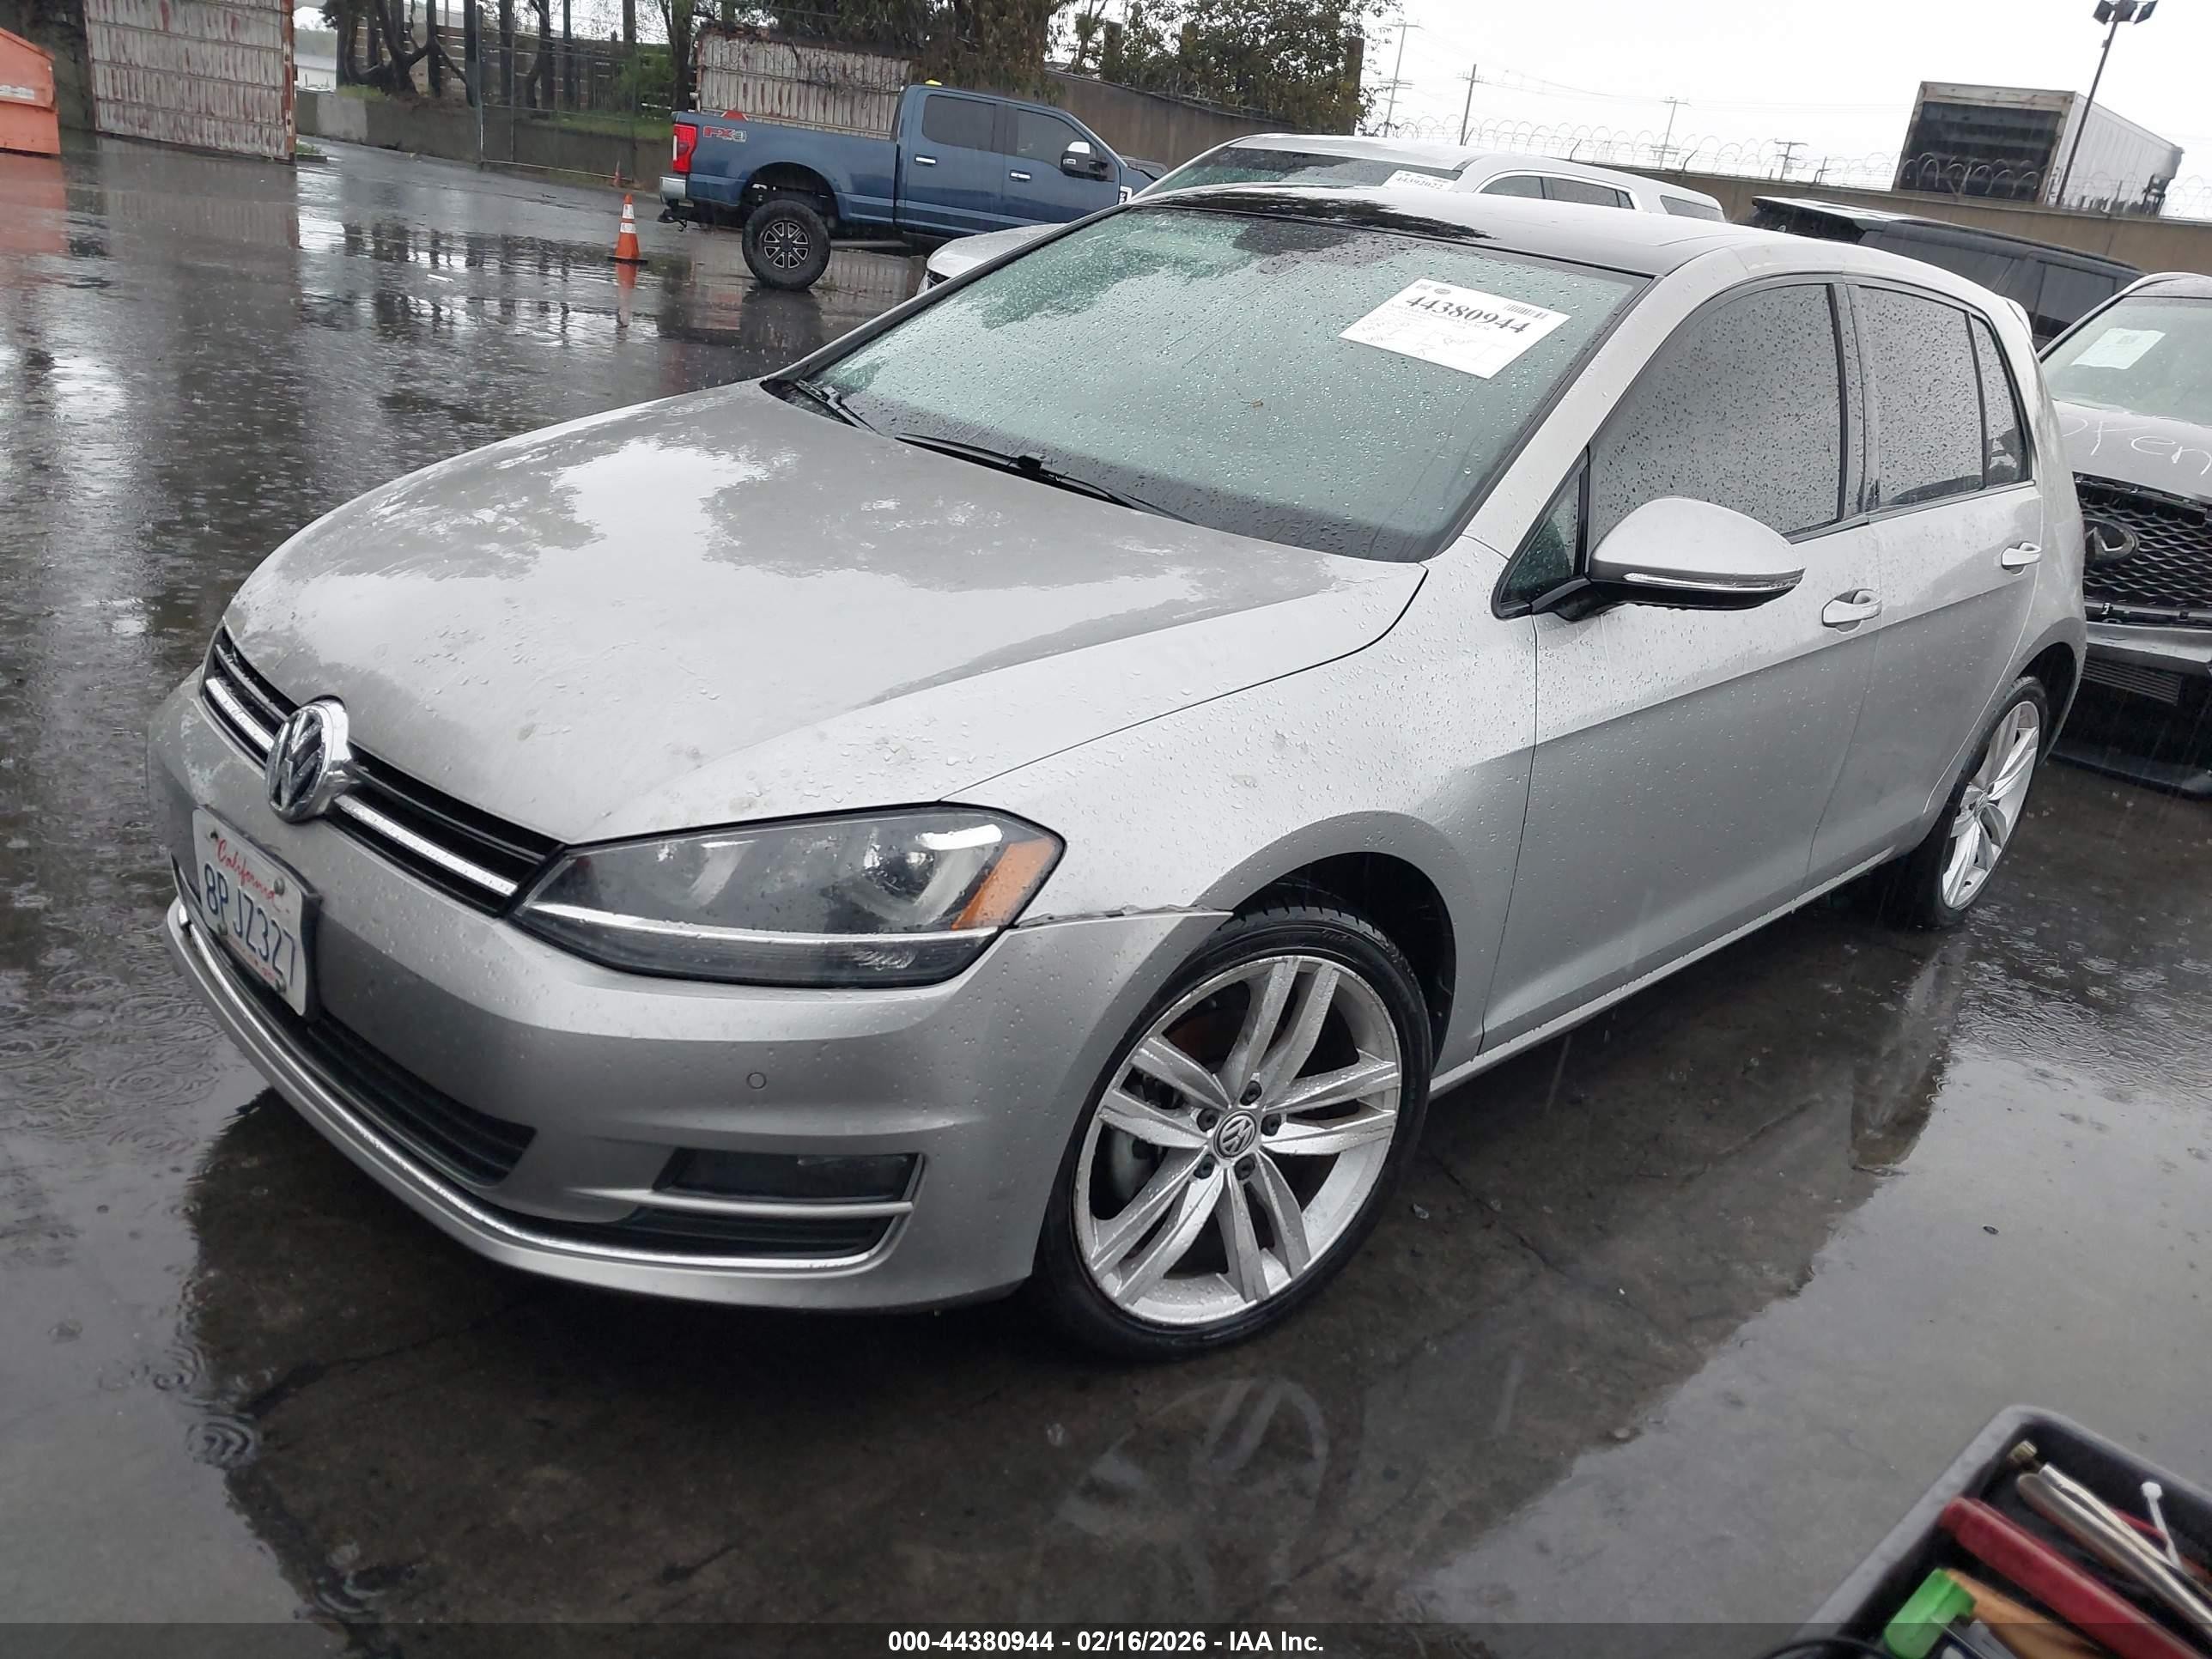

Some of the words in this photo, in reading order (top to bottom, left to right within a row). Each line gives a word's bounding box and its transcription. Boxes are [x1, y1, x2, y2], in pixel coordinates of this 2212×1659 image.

[703, 125, 747, 143] FX4
[1406, 295, 1531, 334] 44380944
[204, 862, 296, 987] 8PJZ327
